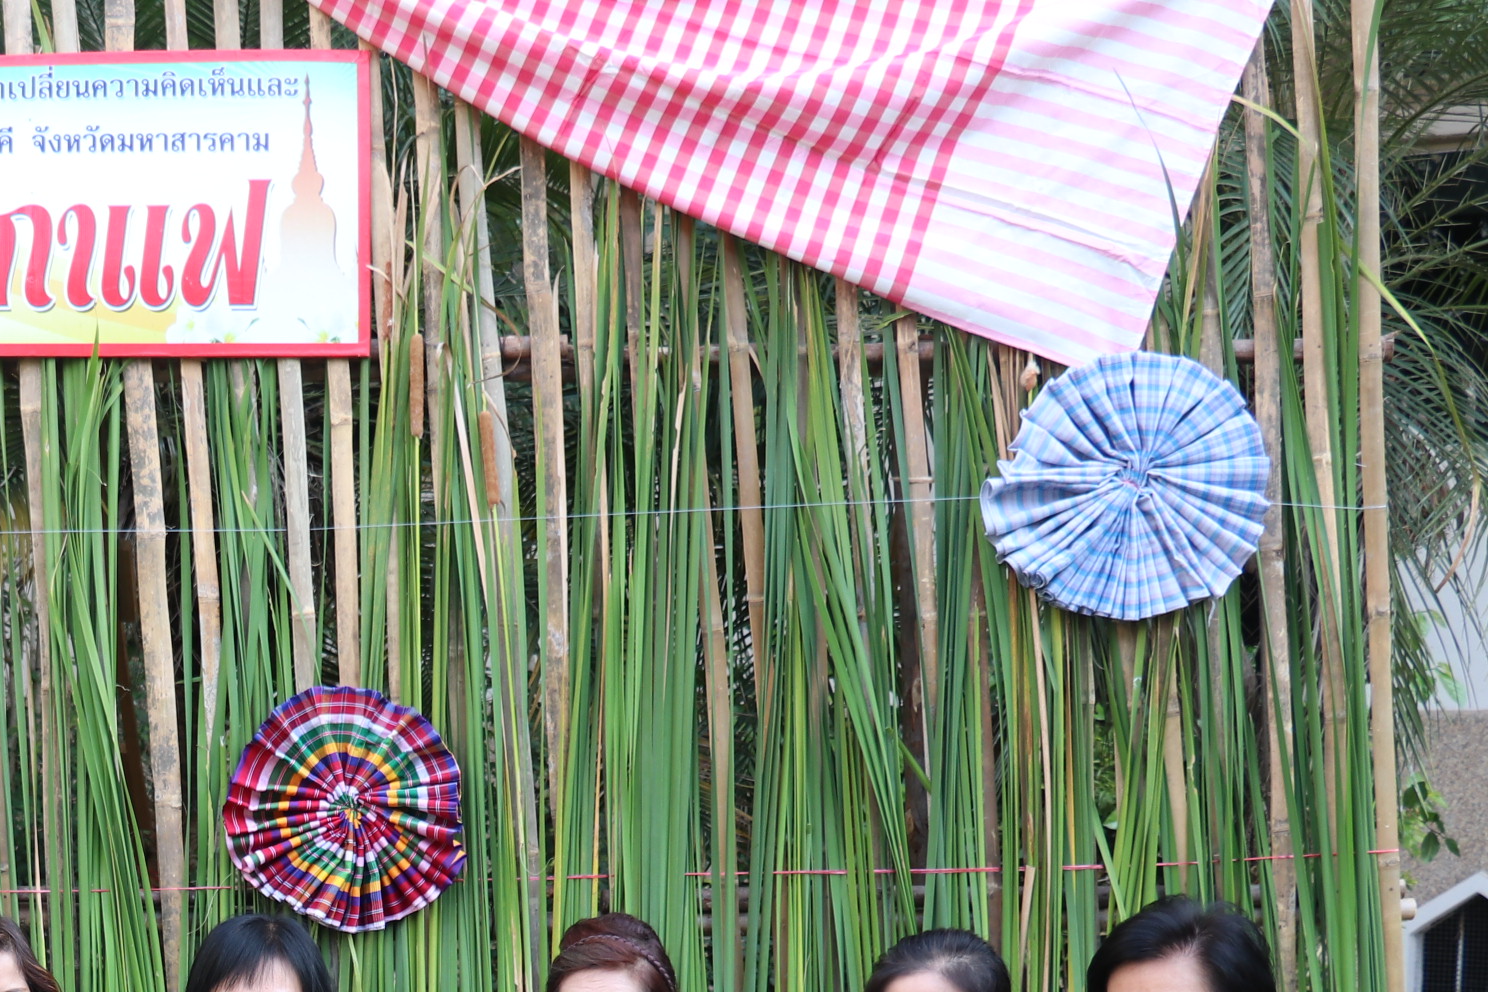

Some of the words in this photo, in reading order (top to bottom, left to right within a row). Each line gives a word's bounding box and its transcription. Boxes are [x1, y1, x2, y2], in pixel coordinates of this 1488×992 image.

[32, 125, 270, 153] จังหวัดมหาสารคาม
